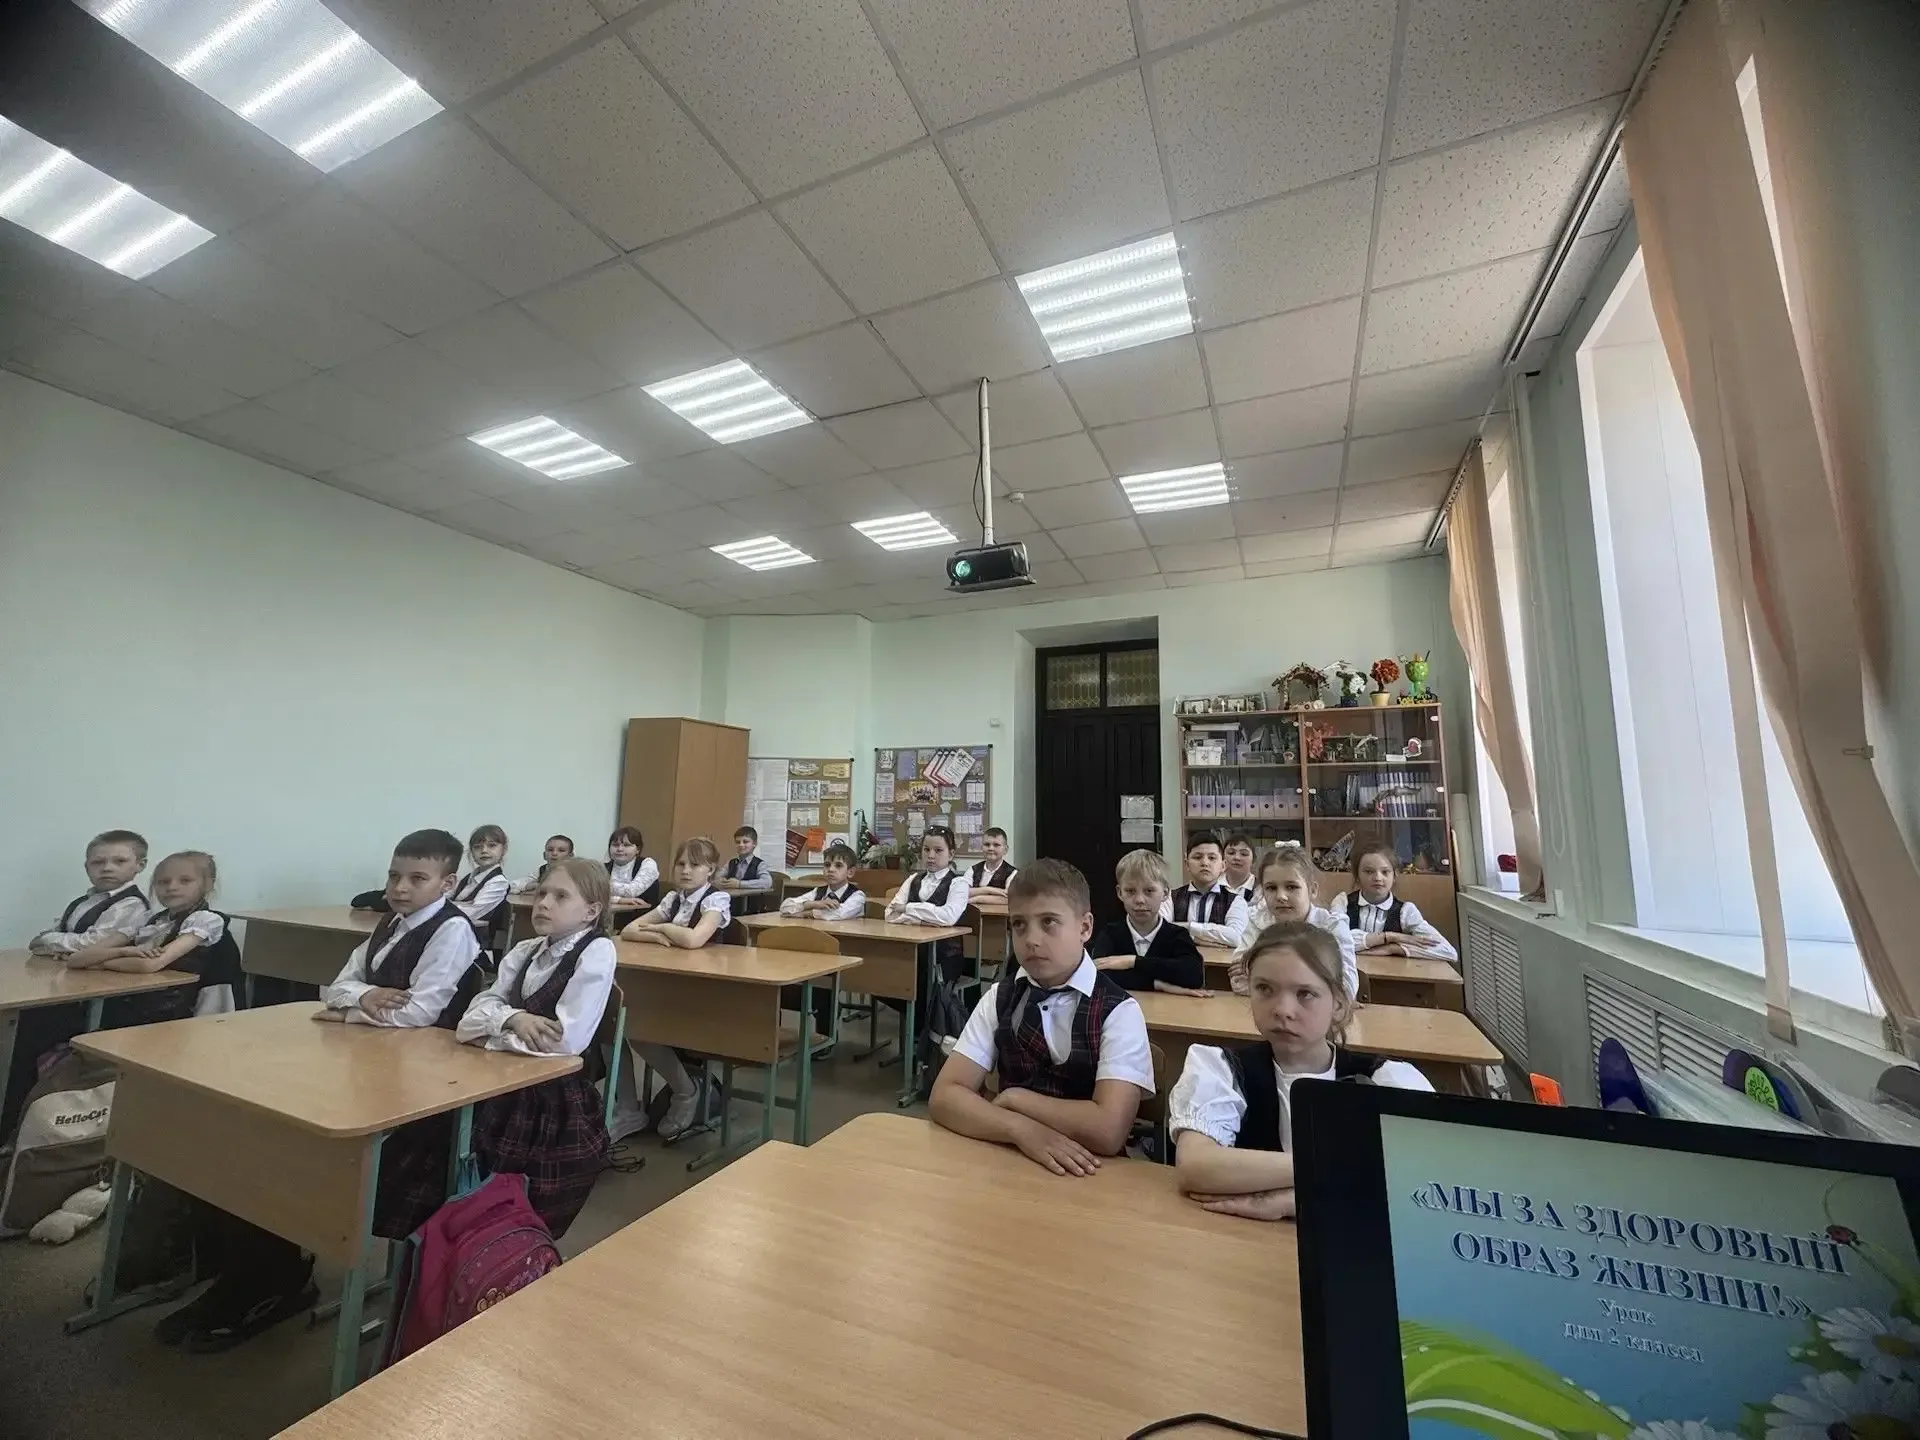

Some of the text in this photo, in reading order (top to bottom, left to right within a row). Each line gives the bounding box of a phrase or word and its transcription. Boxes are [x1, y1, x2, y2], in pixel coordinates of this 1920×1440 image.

[55, 1107, 109, 1125] HelloCat
[1409, 1180, 1849, 1275] «МЫ ЗА ЗДОРОВЫЙ
[1451, 1230, 1814, 1321] ОБРАЗ ЖИЗНИ!»
[1597, 1297, 1657, 1327] Урок
[1563, 1321, 1705, 1364] для 2 класса
